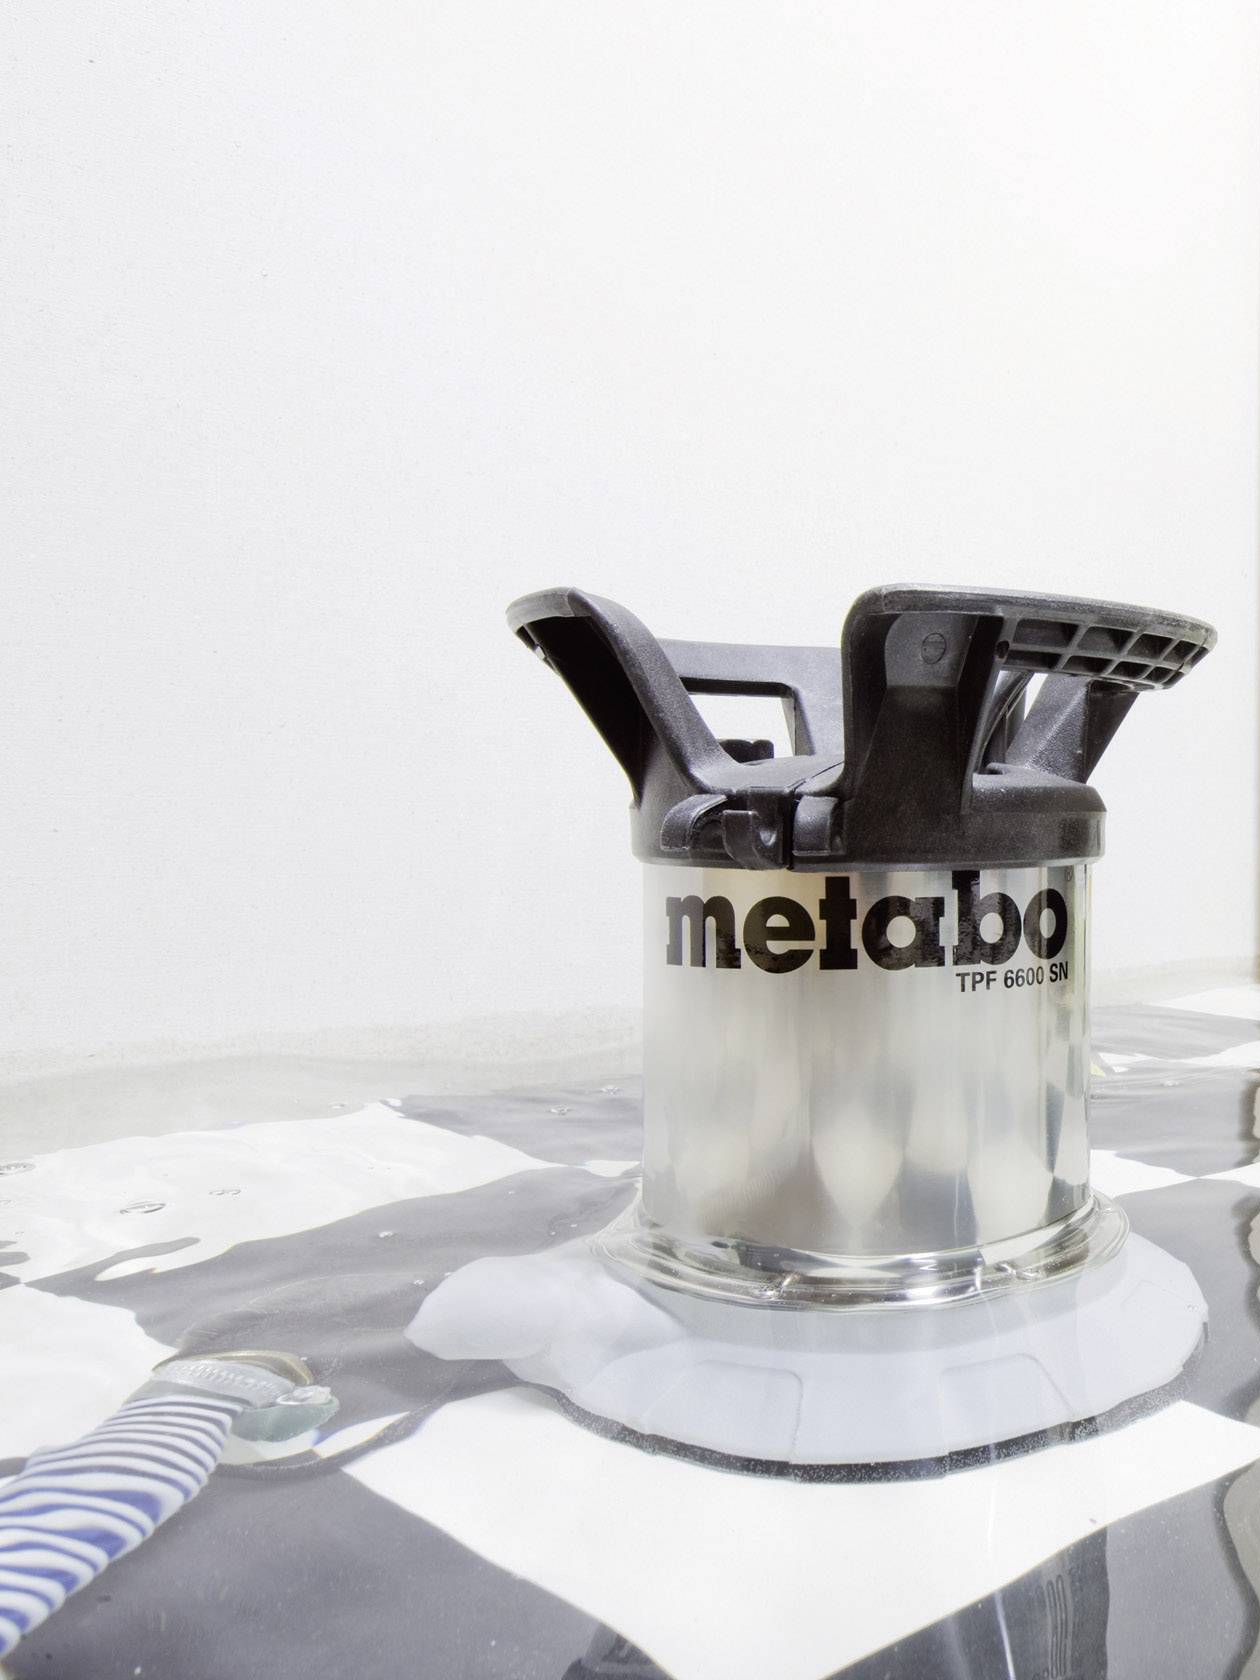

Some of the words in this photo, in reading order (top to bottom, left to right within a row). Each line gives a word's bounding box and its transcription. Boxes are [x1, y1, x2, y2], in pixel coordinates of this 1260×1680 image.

[666, 870, 1068, 974] metabo
[956, 971, 998, 993] TPF
[1003, 966, 1045, 990] 6600
[1049, 961, 1069, 983] SN
